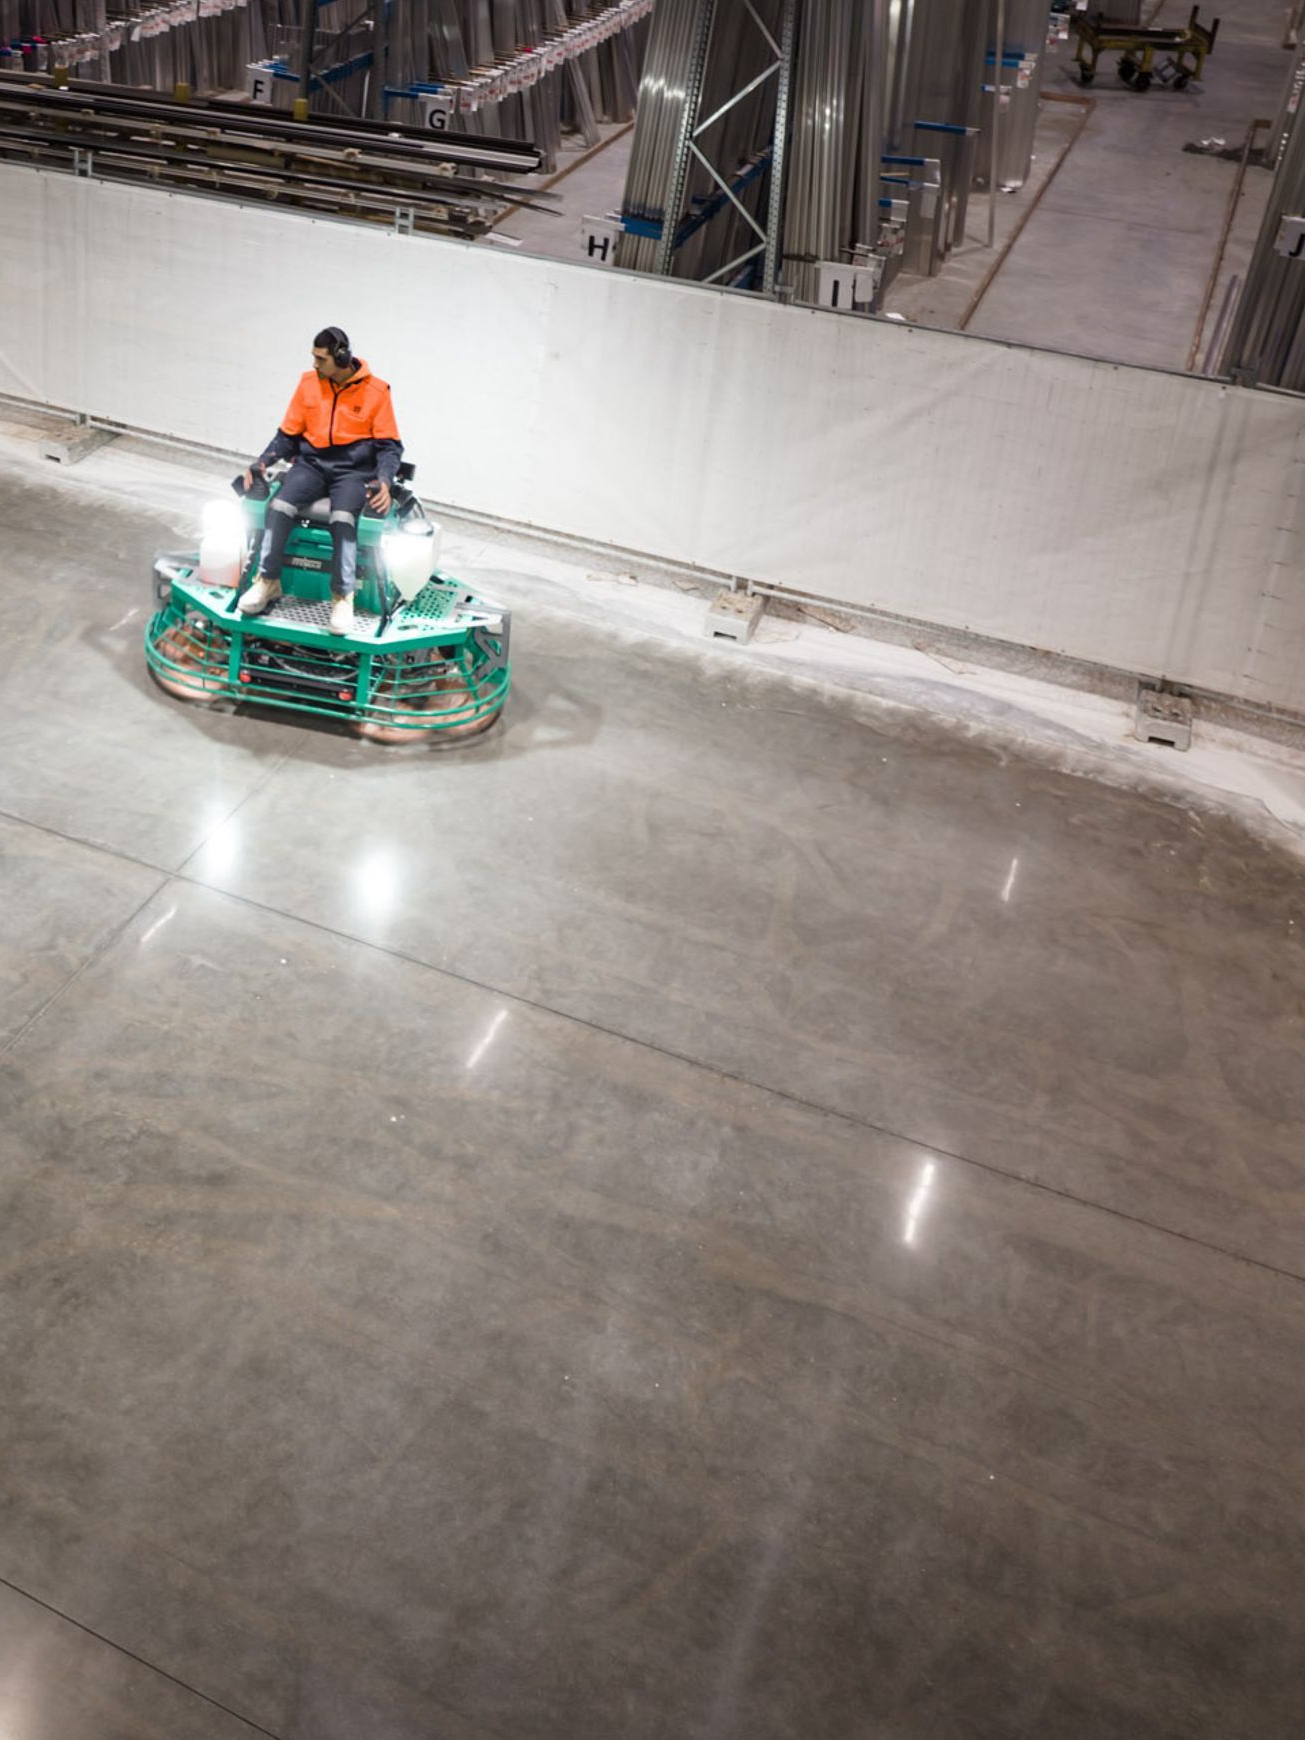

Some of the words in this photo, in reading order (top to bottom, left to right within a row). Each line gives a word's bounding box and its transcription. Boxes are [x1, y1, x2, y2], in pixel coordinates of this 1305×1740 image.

[253, 79, 264, 100] F
[428, 108, 447, 129] G
[588, 235, 609, 262] H
